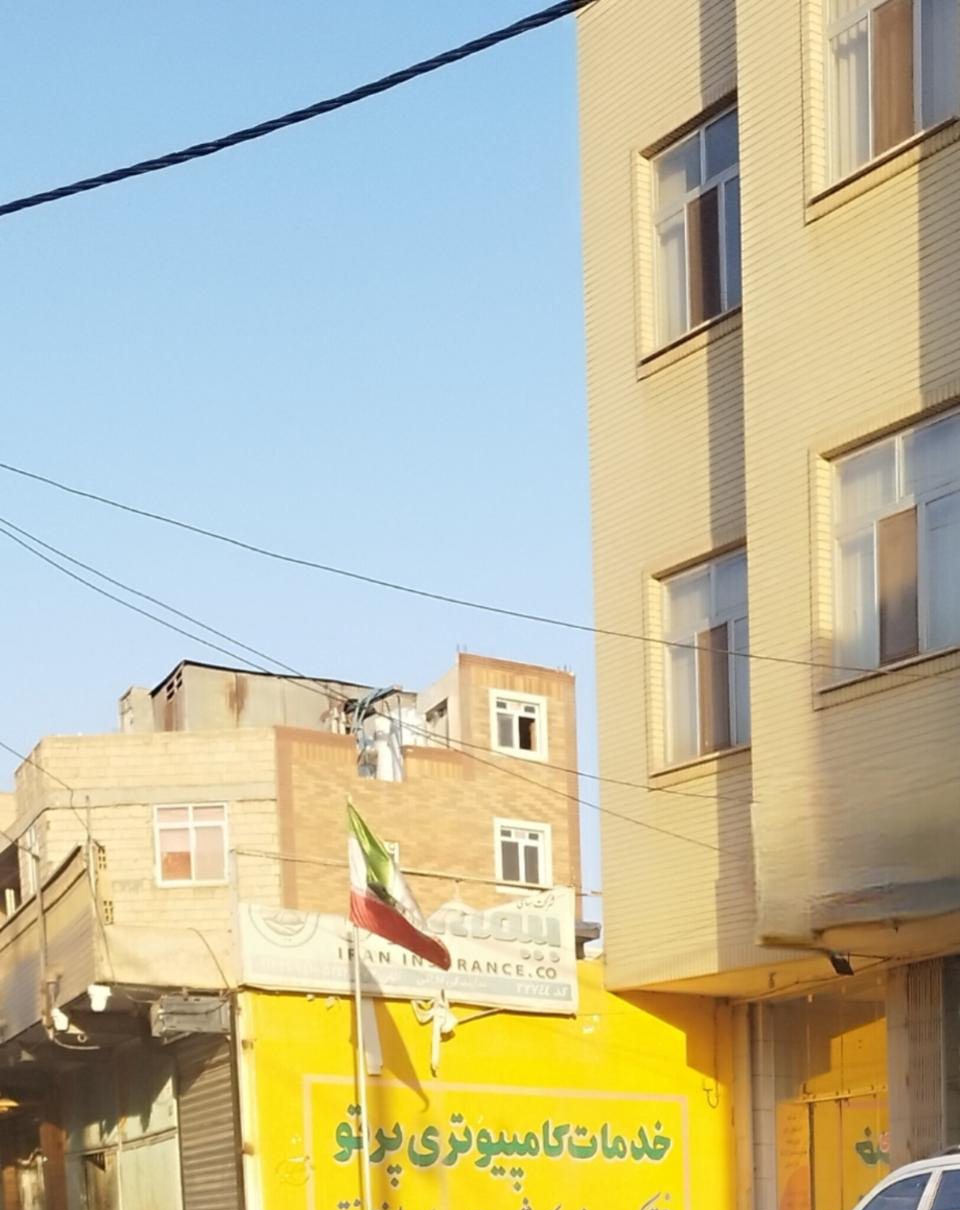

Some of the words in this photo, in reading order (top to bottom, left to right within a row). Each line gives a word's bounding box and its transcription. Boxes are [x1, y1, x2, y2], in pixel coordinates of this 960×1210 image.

[402, 952, 558, 980] INRANCE.CO
[407, 1111, 571, 1192] کامپیوتری
[567, 1119, 673, 1162] خدمات
